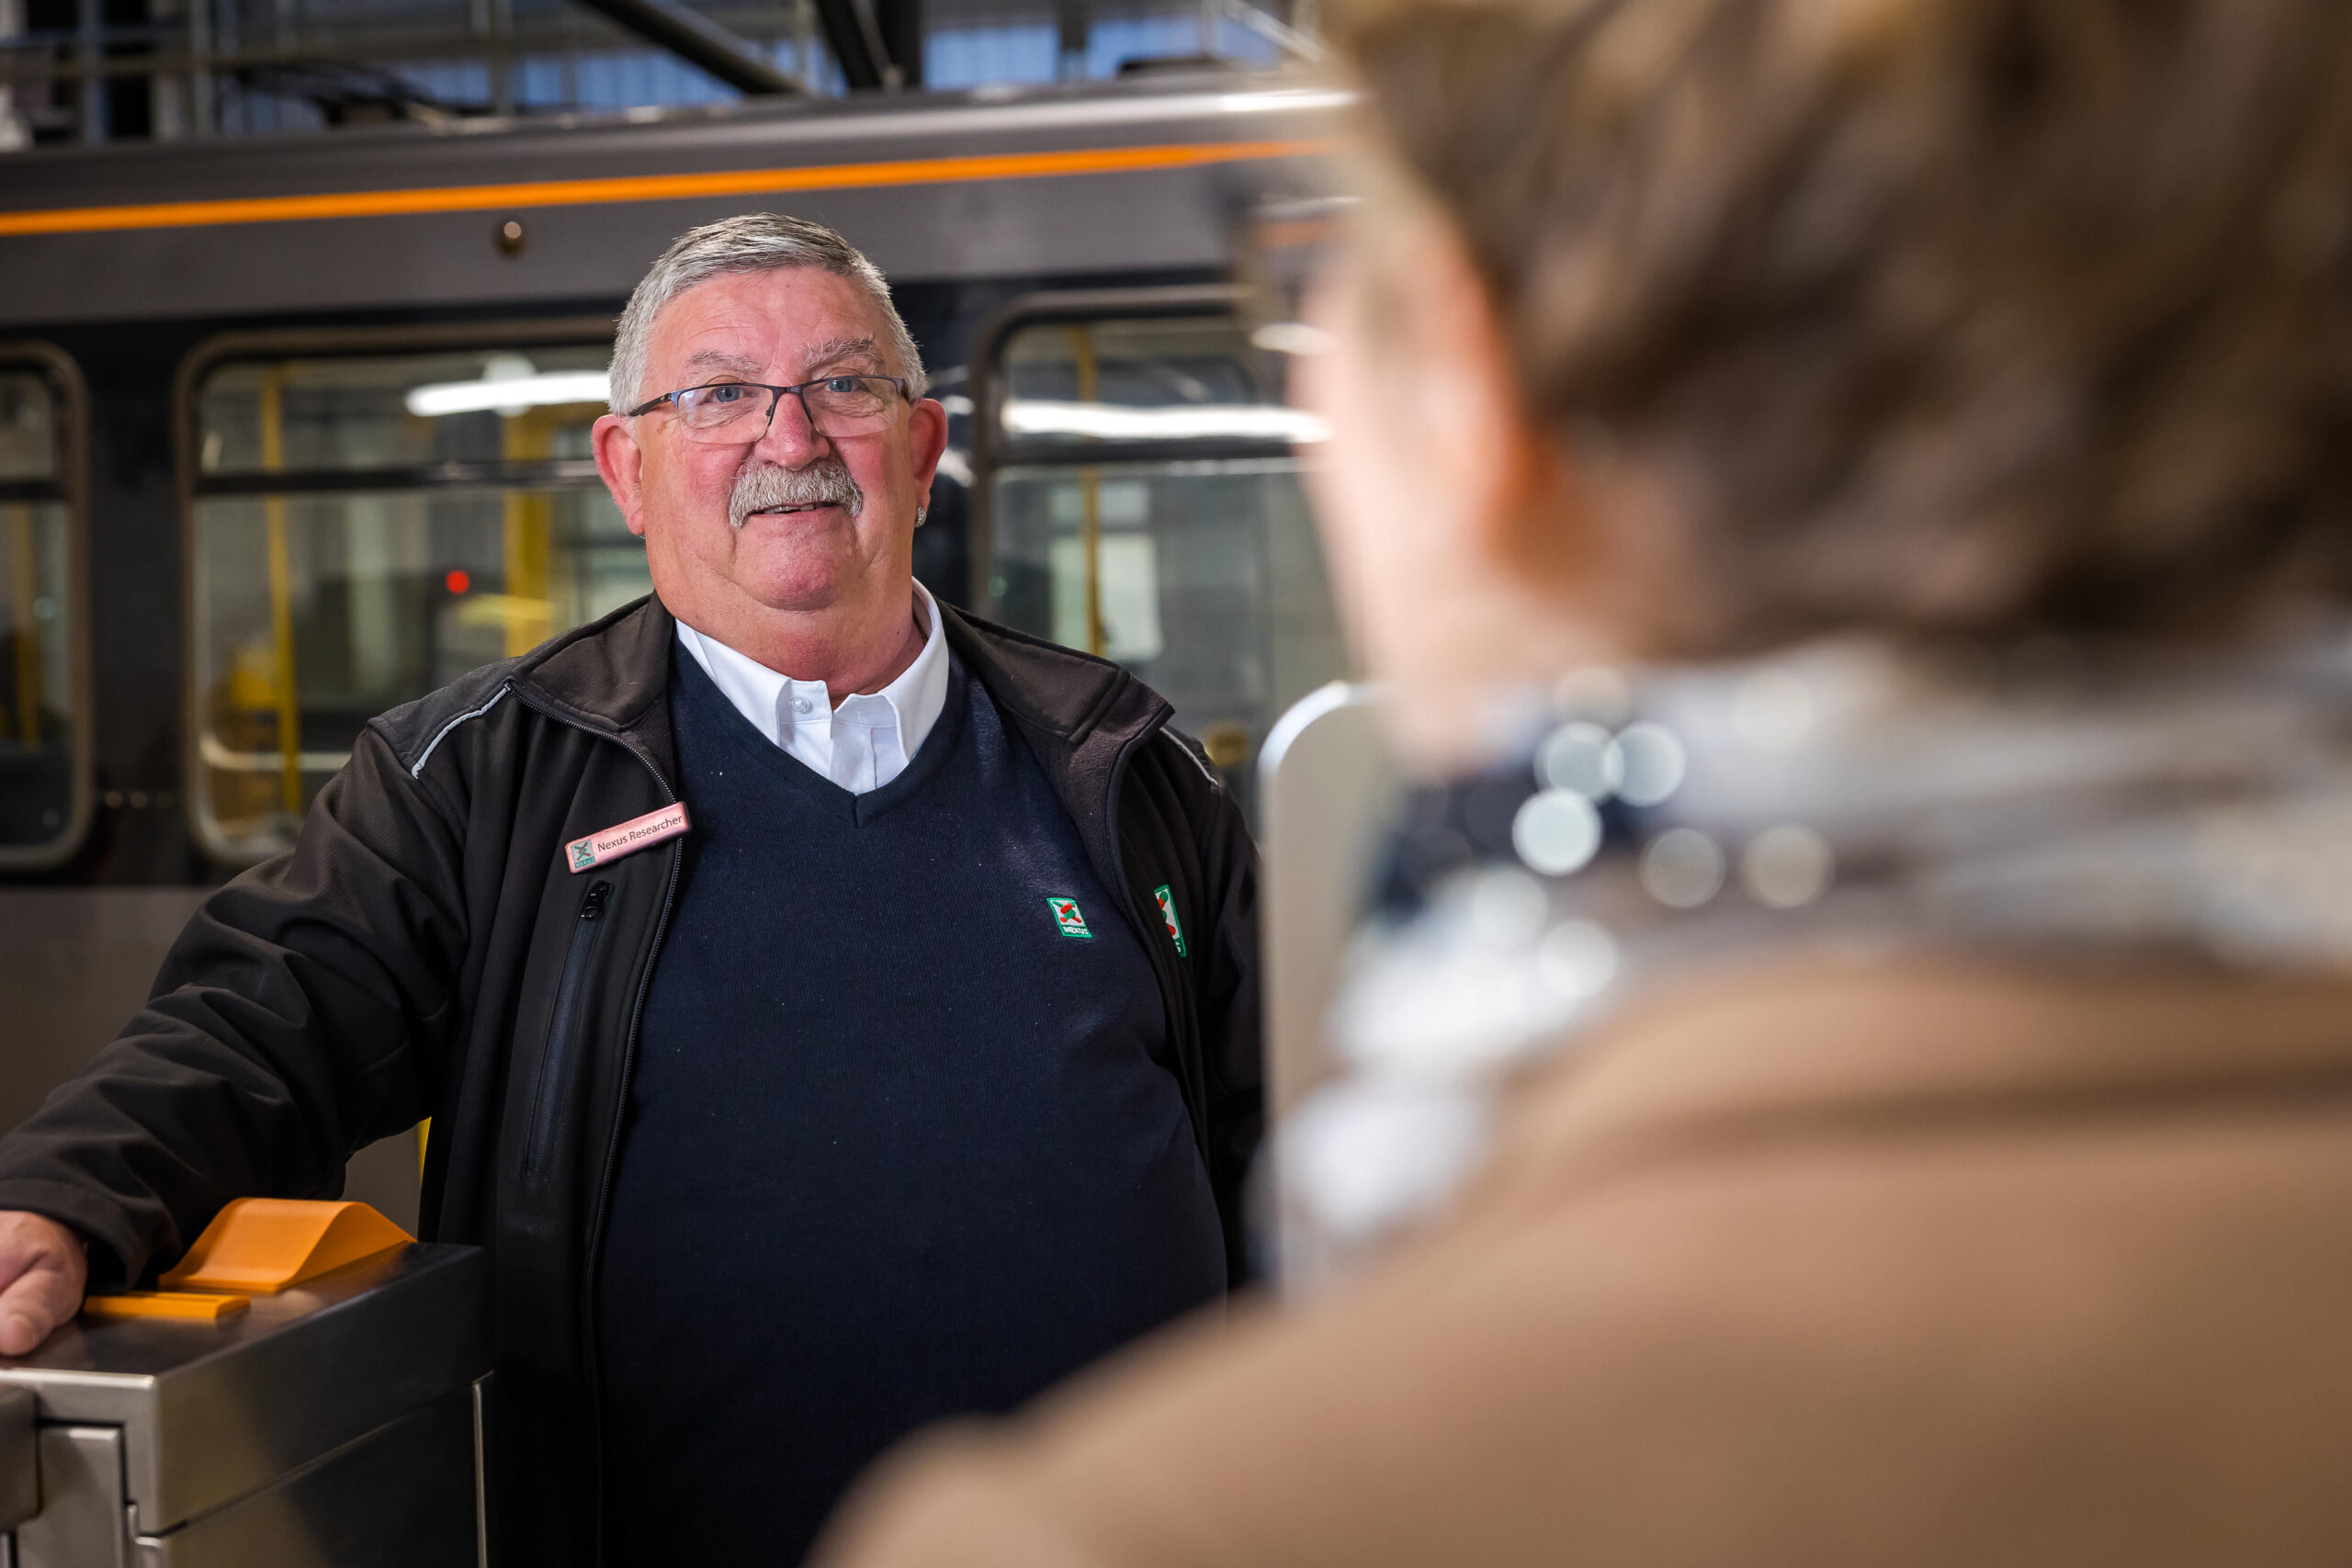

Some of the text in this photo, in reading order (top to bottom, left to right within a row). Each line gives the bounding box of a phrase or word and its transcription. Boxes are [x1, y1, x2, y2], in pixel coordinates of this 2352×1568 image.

[597, 816, 683, 852] Nexus Researcher
[575, 858, 595, 868] NEXUS
